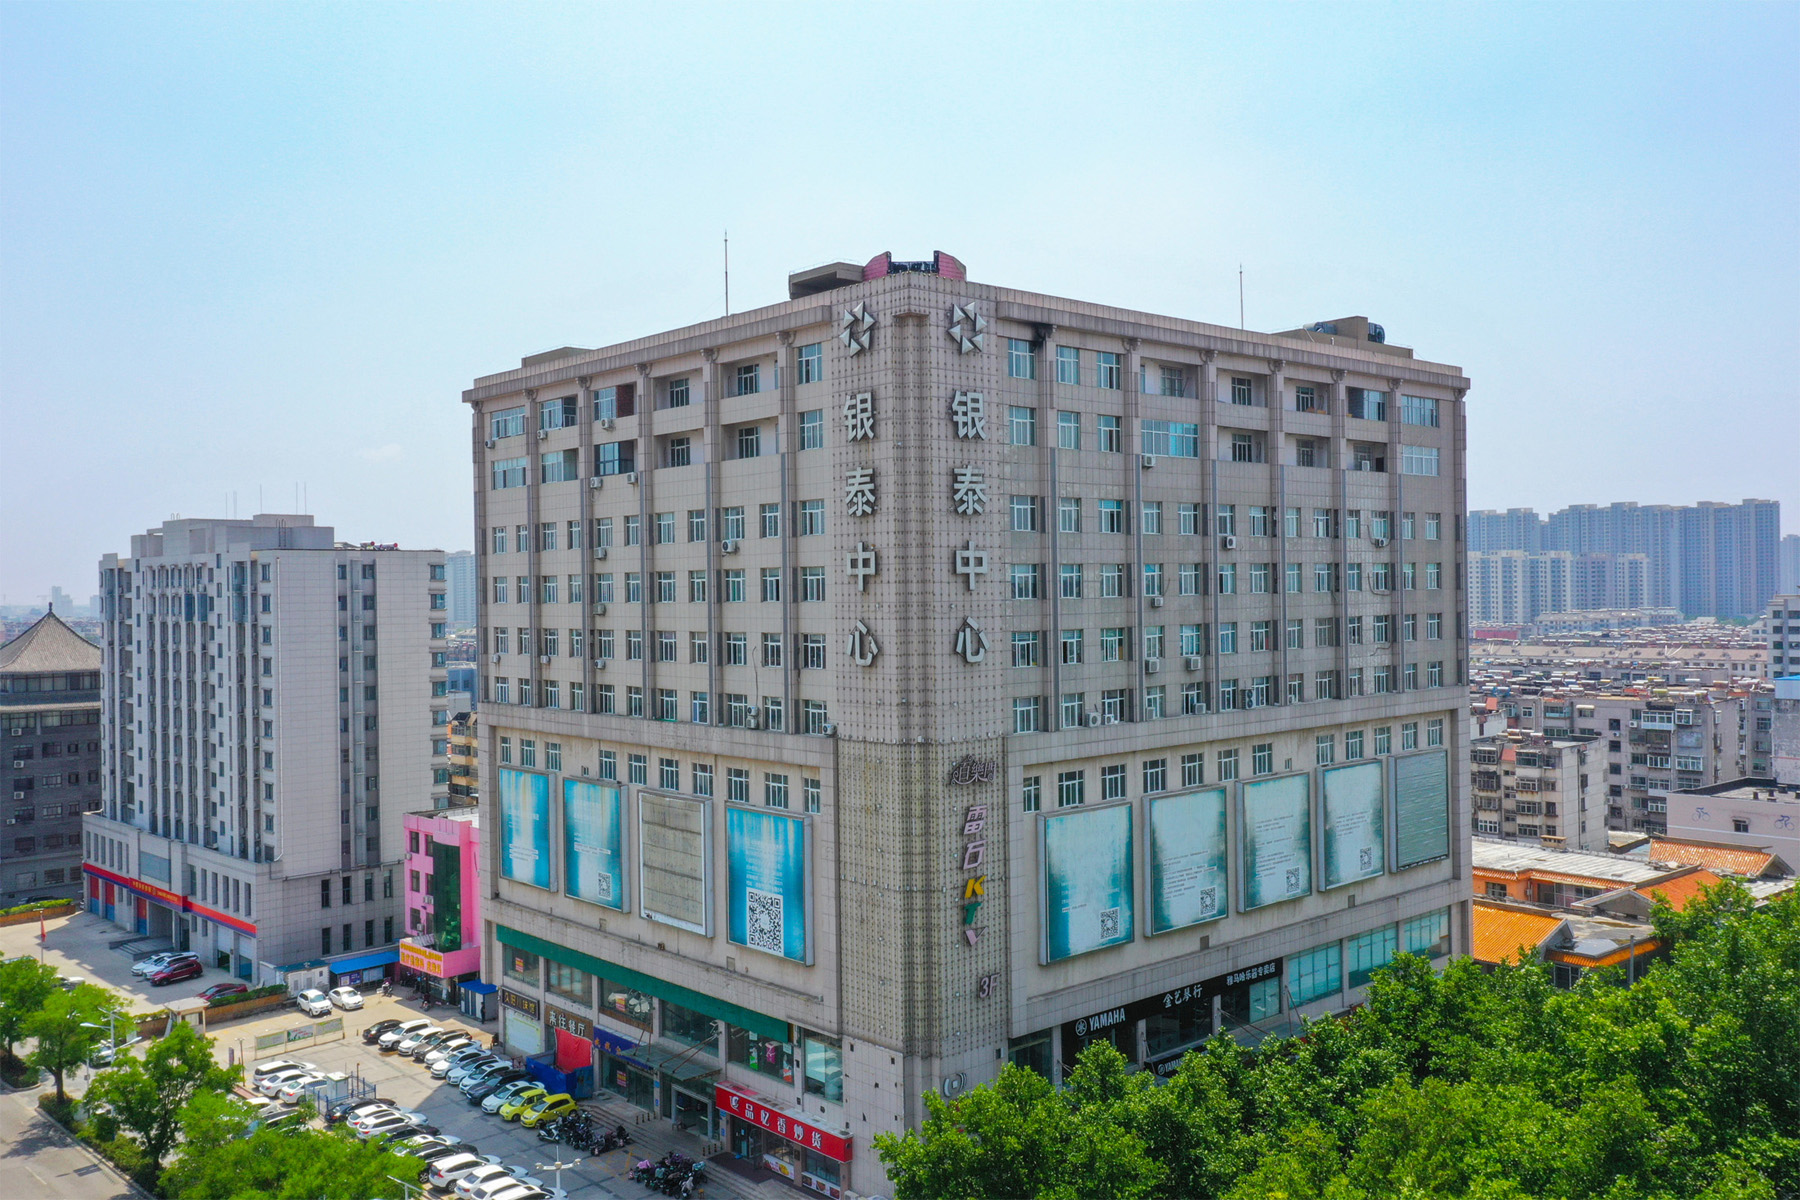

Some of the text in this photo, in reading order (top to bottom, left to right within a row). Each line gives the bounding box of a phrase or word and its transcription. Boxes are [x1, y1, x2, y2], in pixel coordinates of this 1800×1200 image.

[843, 391, 879, 667] 银泰中心
[951, 389, 990, 664] 银泰中心
[979, 973, 1000, 998] 3F
[1226, 962, 1276, 986] 雅马哈乐器专卖店
[1163, 984, 1203, 1009] 金艺琴行
[1089, 1007, 1126, 1032] YAMAHA
